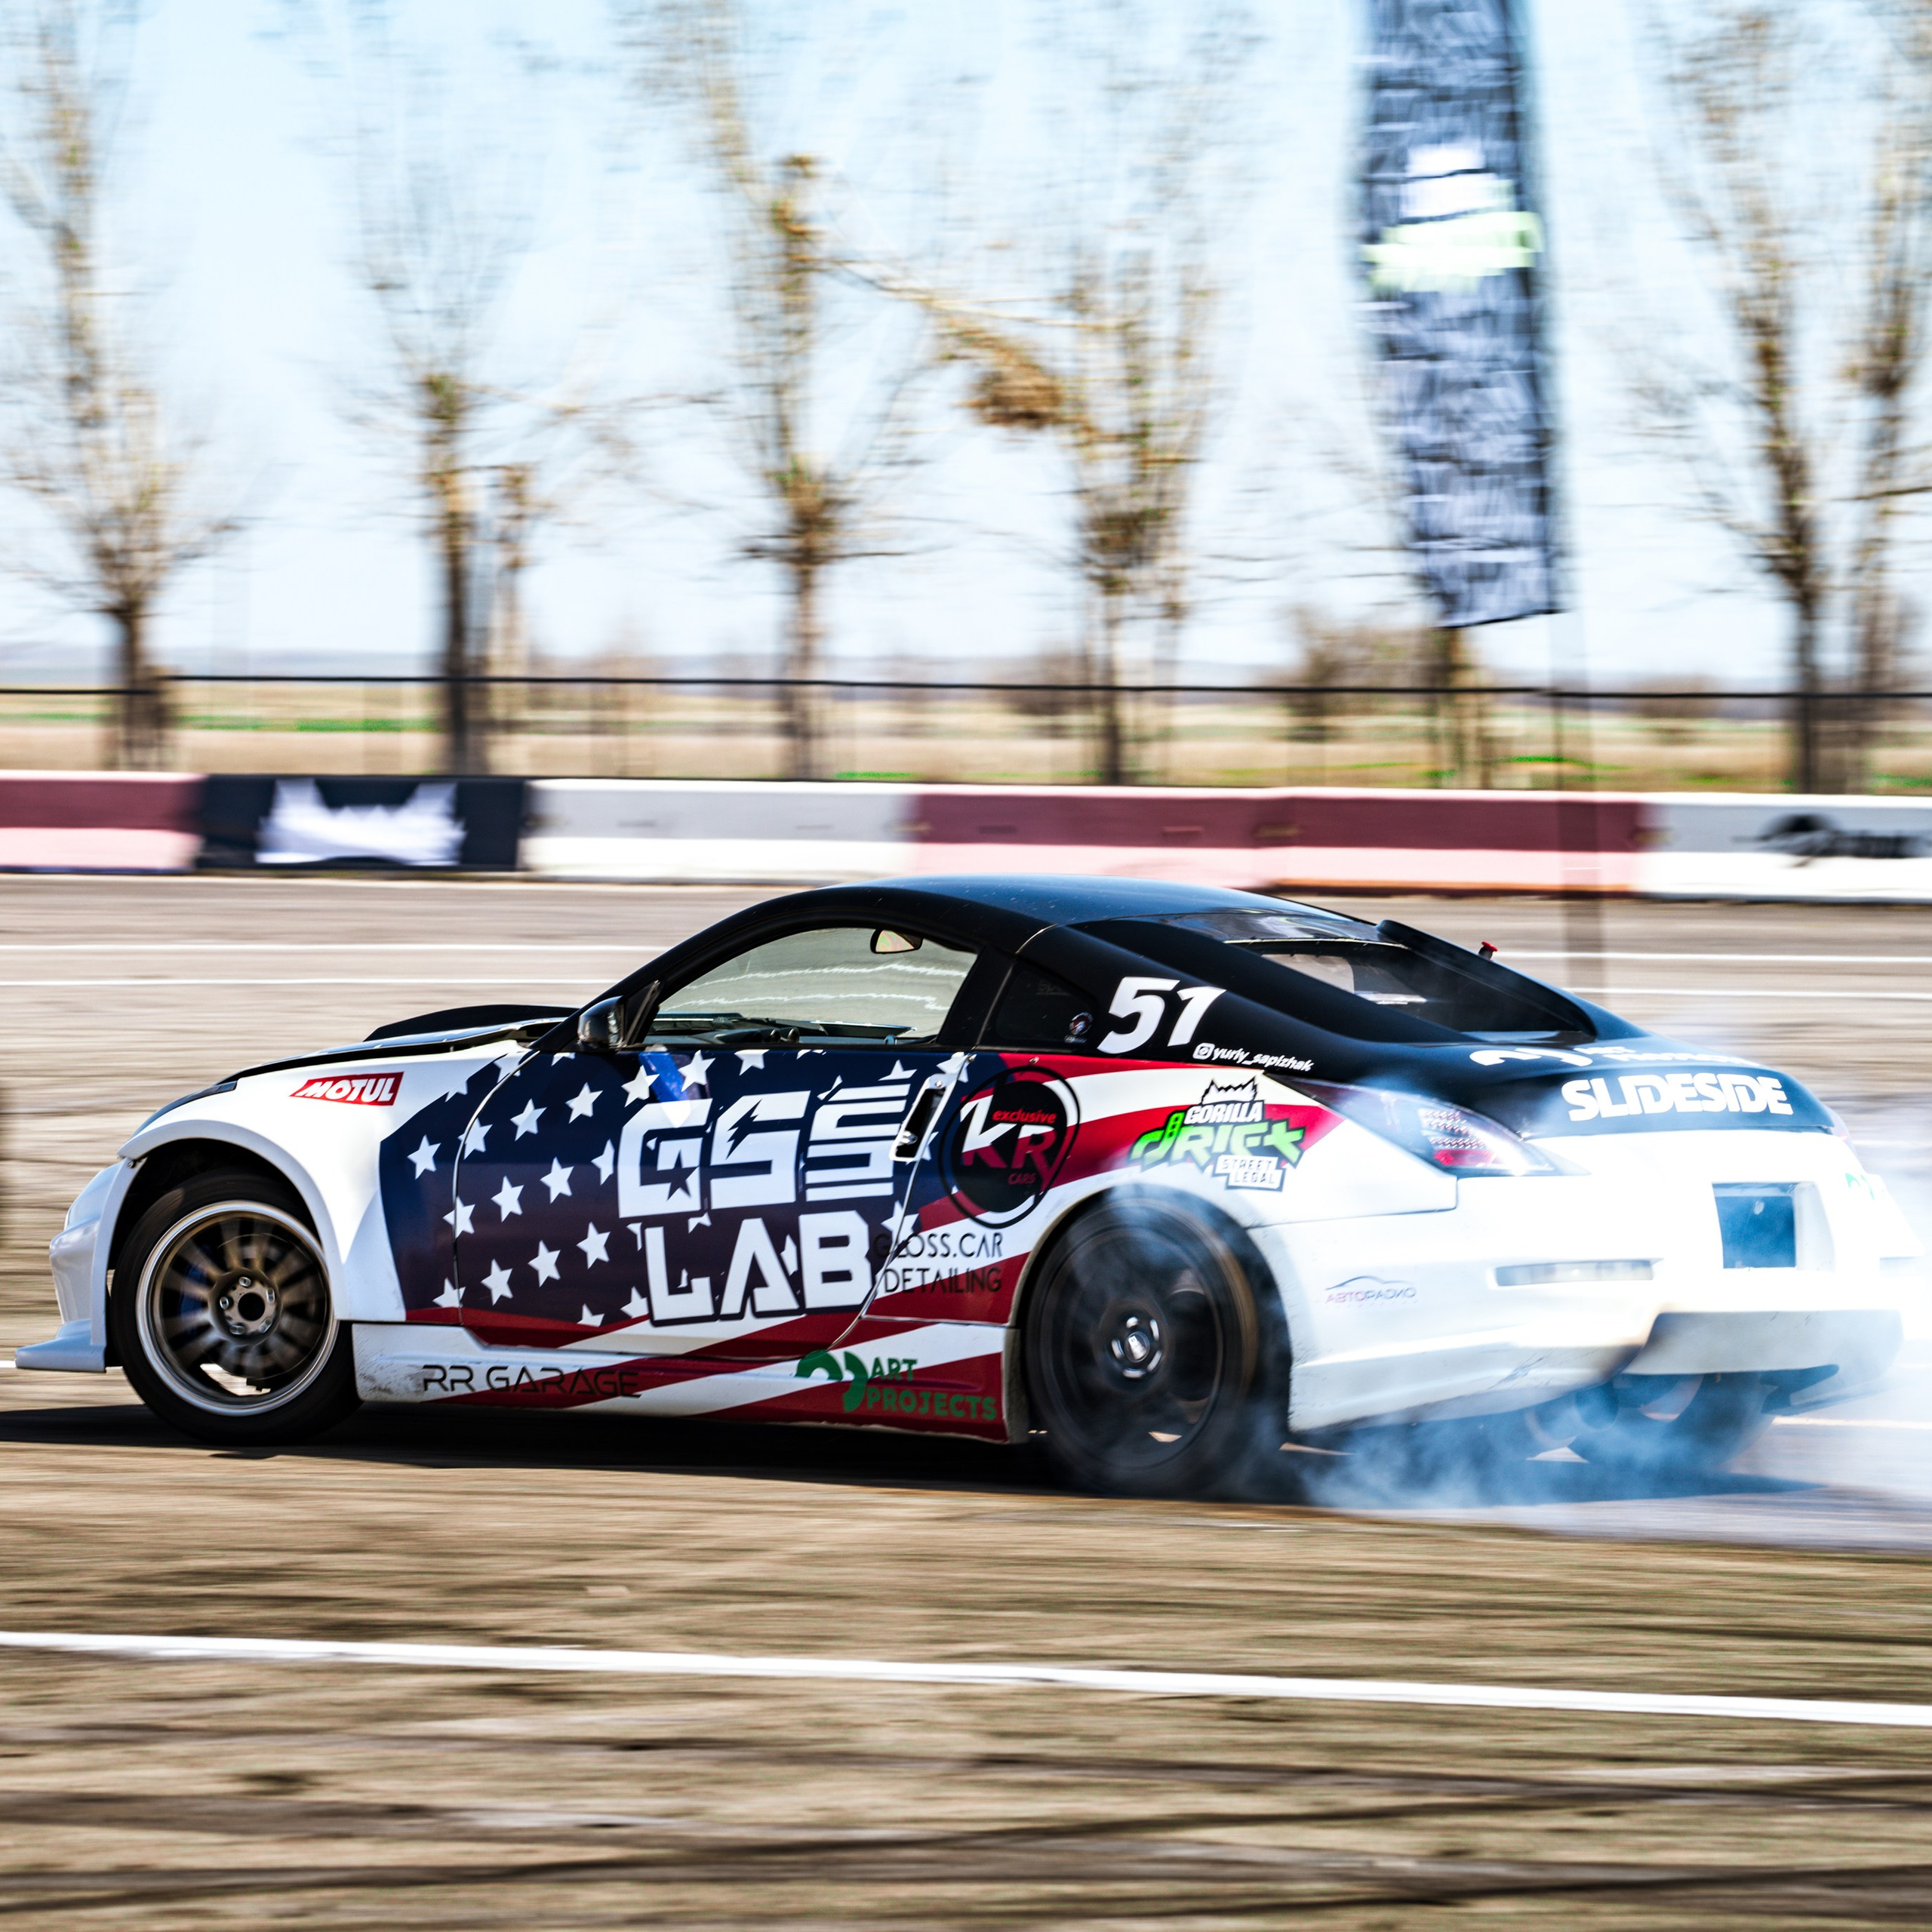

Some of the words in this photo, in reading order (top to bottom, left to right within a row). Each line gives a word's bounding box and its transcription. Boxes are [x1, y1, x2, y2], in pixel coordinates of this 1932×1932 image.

[1097, 977, 1226, 1054] 51
[294, 1077, 395, 1103] MOTUL
[1561, 1072, 1794, 1121] SLIDESIDE
[992, 1109, 1057, 1124] exclusive
[1184, 1101, 1263, 1124] GORILLA
[1221, 1159, 1273, 1170] STREET
[1234, 1171, 1275, 1184] LEGAL
[645, 1210, 873, 1321] LAB
[883, 1268, 1002, 1294] DETAILING
[423, 1364, 477, 1392] RR
[486, 1365, 642, 1399] GARAGE
[868, 1357, 917, 1382] ART
[867, 1386, 997, 1420] PROJECTS
